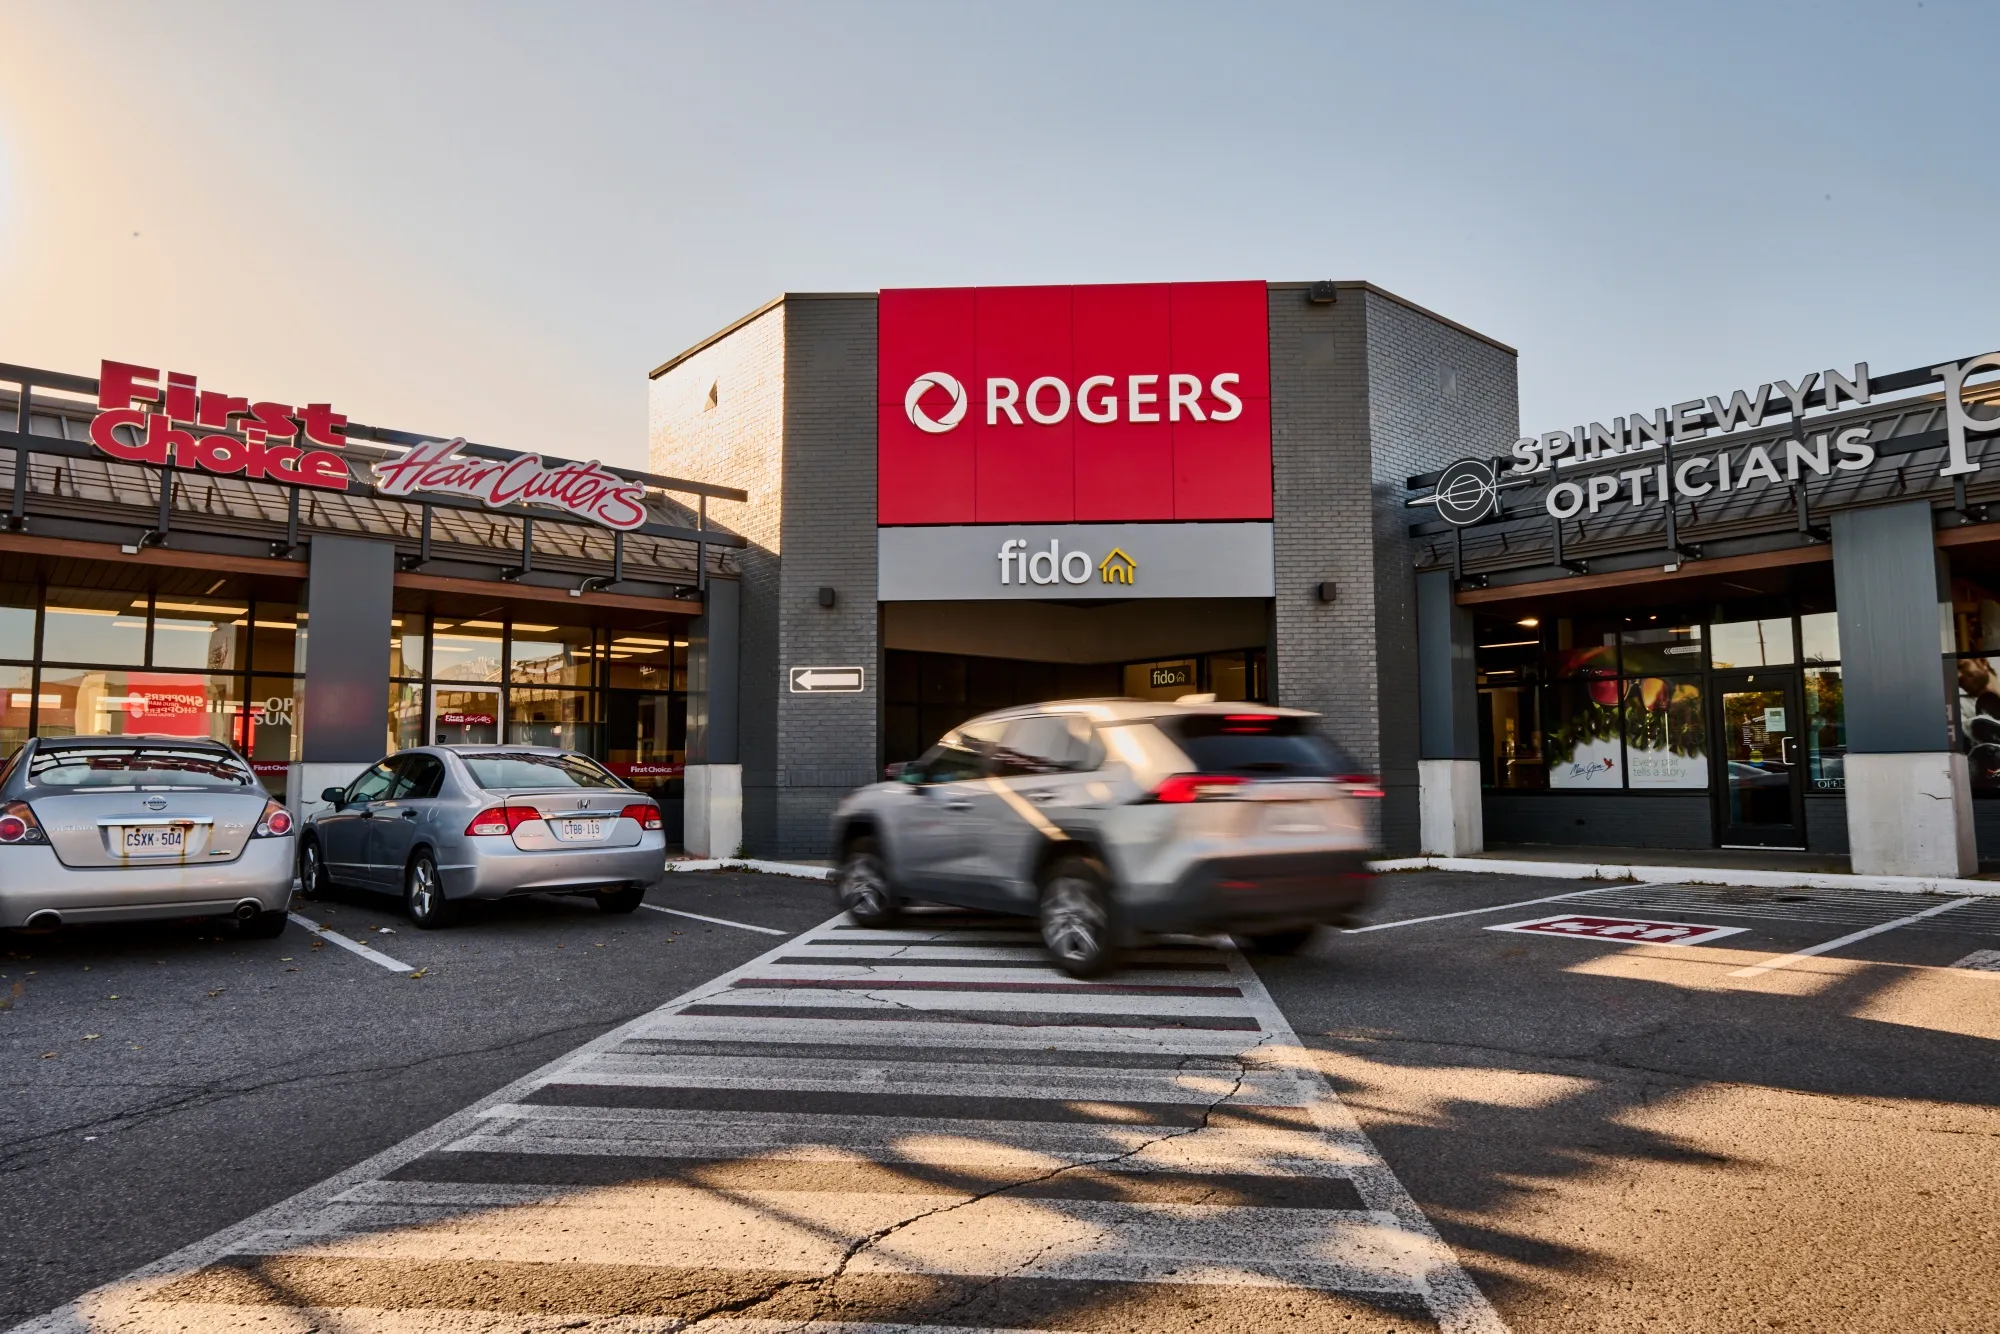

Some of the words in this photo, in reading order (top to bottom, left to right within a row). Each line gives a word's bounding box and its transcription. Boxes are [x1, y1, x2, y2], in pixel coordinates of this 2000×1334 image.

[97, 359, 347, 447] First
[986, 373, 1243, 425] ROGERS
[1511, 361, 1871, 473] SPINNEWYN
[89, 408, 349, 490] Choice
[378, 440, 506, 491] Hair
[1546, 427, 1875, 519] OPTICIANS
[997, 539, 1093, 584] fido
[1153, 669, 1175, 685] fido
[1632, 758, 1658, 768] Every
[1661, 758, 1679, 768] pair
[1633, 768, 1651, 777] tells
[1654, 769, 1659, 777] a
[1661, 768, 1688, 778] story.
[127, 832, 154, 847] CSXK
[161, 832, 182, 846] 504
[586, 824, 600, 834] 119
